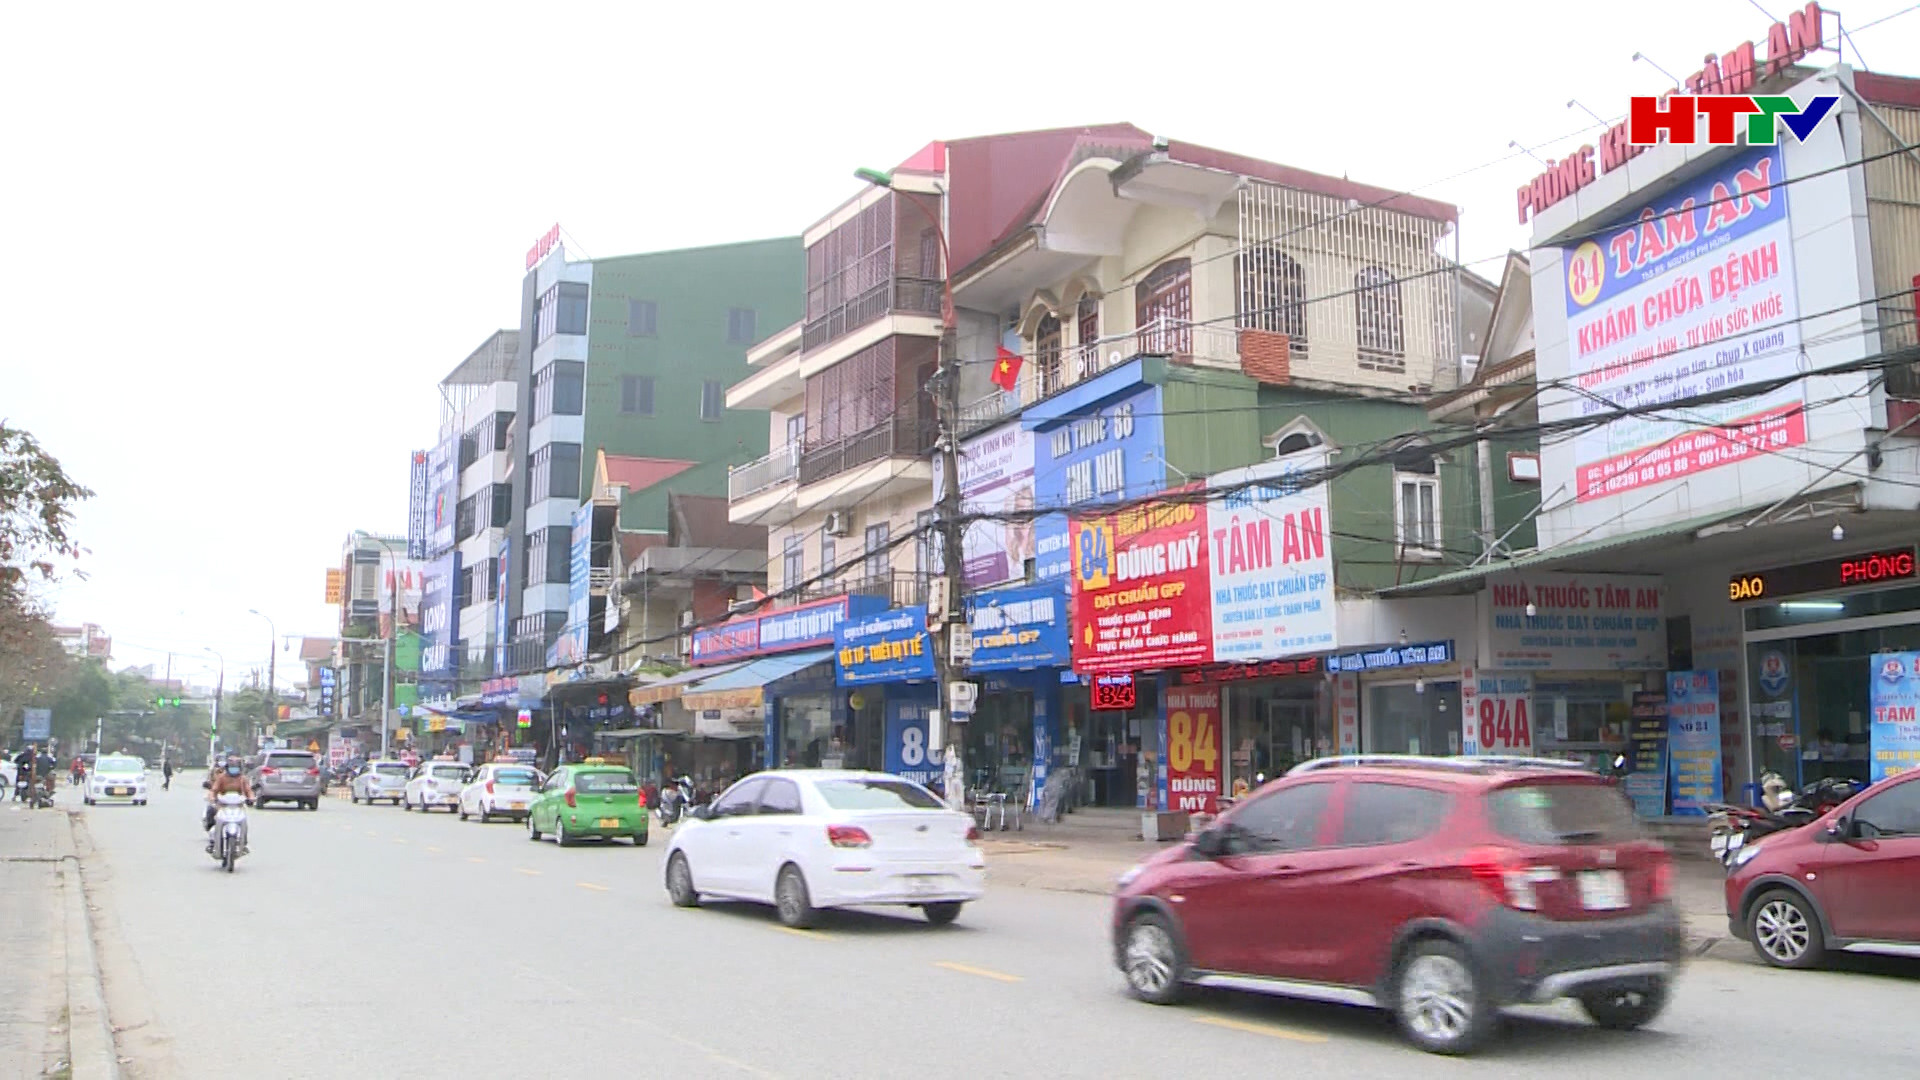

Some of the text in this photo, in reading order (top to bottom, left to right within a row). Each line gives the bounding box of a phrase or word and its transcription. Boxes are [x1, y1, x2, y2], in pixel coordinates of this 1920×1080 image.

[1517, 144, 1596, 225] PHÒNG
[1766, 1, 1823, 77] AN
[1611, 158, 1771, 275] TÂM AN
[1572, 250, 1600, 297] 84
[1578, 241, 1779, 355] KHÁM CHỮA BỆNH
[1727, 304, 1749, 334] SỨC
[1743, 341, 1750, 356] X
[1753, 331, 1785, 355] quang
[1113, 403, 1133, 440] 86
[1080, 527, 1108, 580] 84
[1117, 529, 1200, 582] DŨNG MỸ
[1213, 507, 1324, 576] TÂM AN
[1493, 578, 1659, 609] NHÀ THUỐC TÂM AN
[424, 603, 446, 634] LONG
[1188, 692, 1217, 708] THUỐC
[1479, 698, 1531, 749] 84A
[1170, 711, 1216, 772] 84
[1171, 776, 1216, 793] DŨNG
[1179, 794, 1207, 810] MỸ
